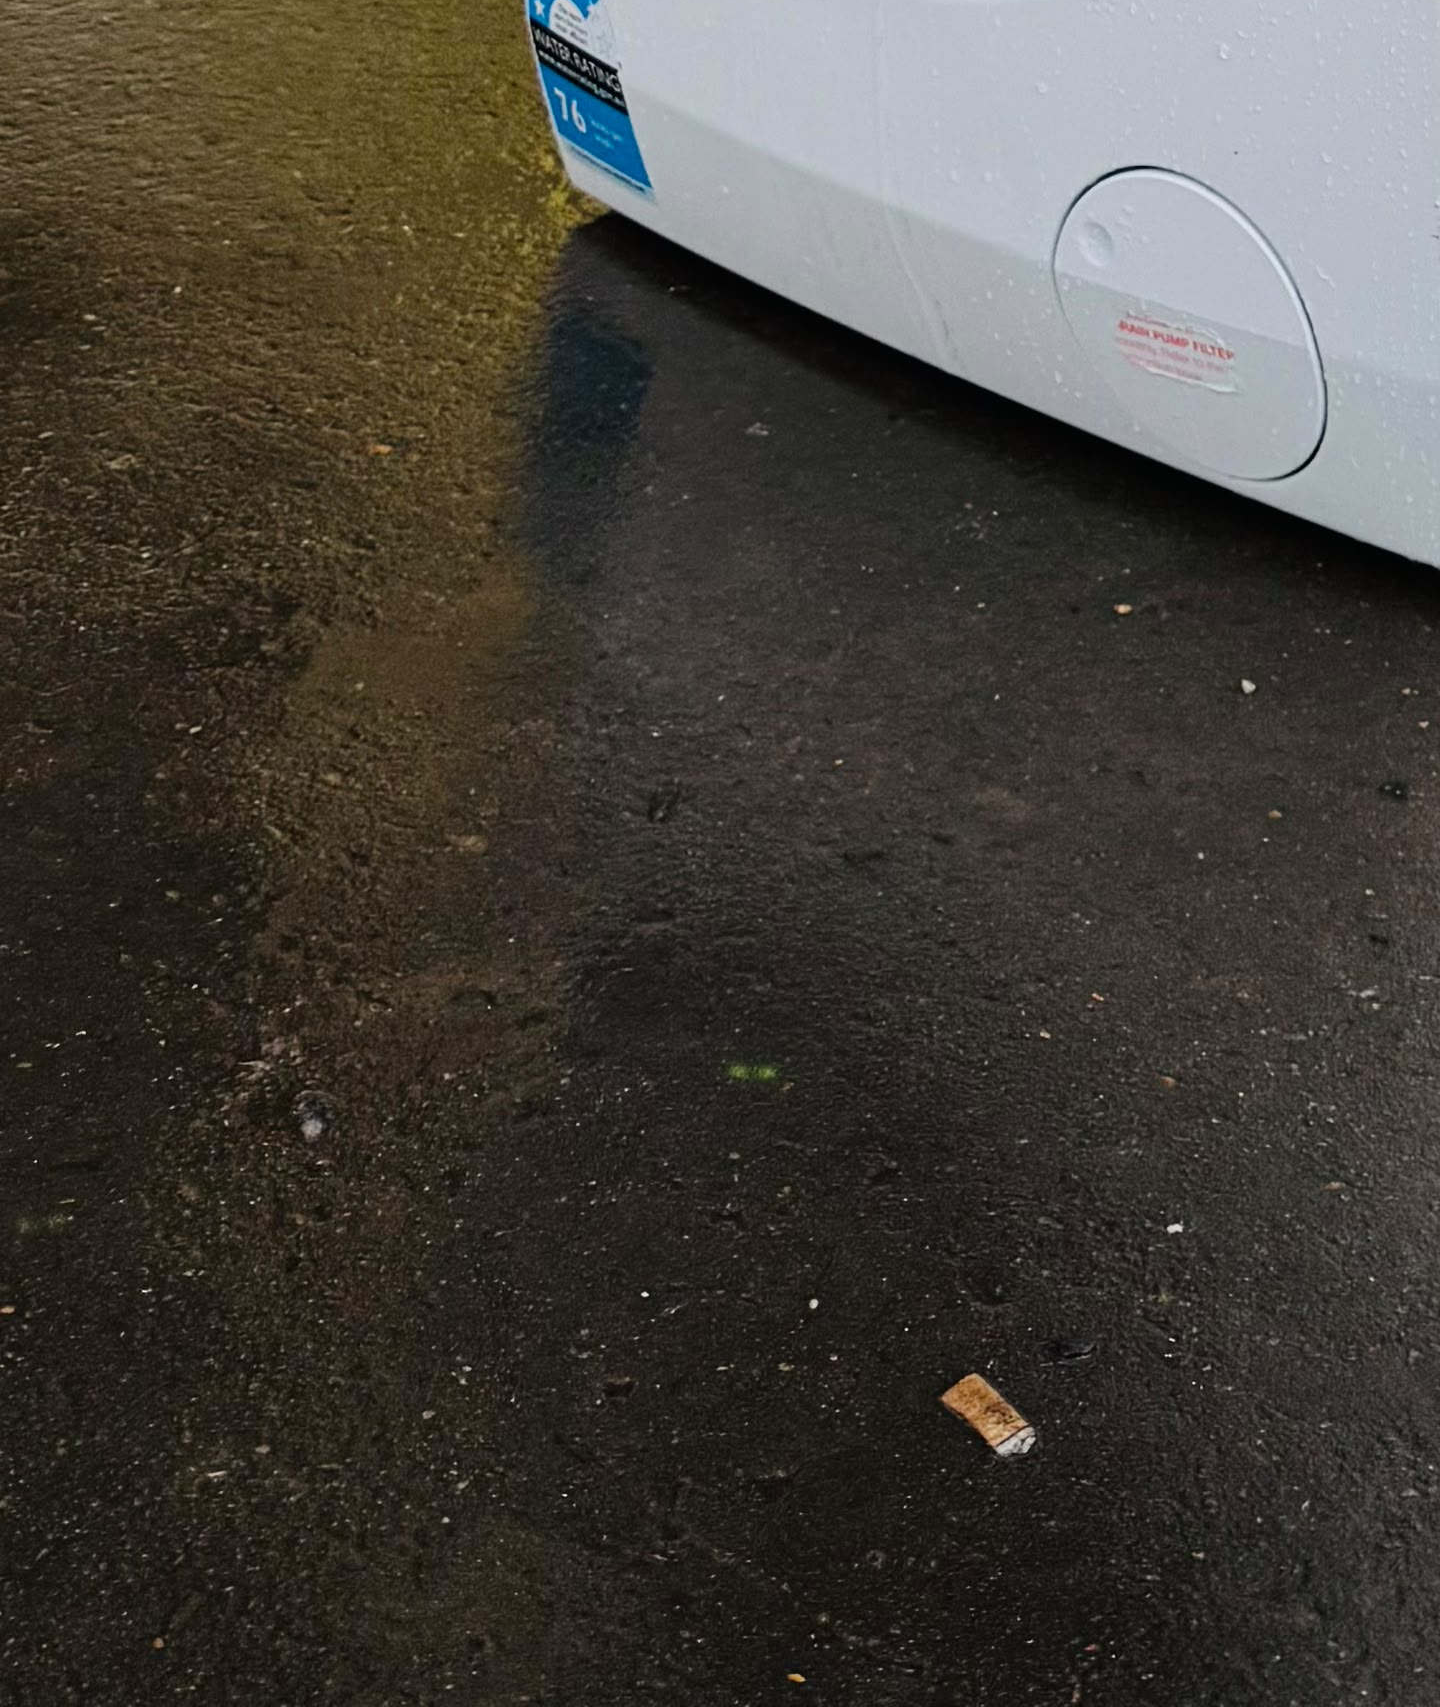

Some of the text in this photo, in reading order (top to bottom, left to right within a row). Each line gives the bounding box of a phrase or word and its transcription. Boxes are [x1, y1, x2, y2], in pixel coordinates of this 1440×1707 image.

[532, 26, 621, 92] WATER RATING
[554, 87, 587, 134] 76
